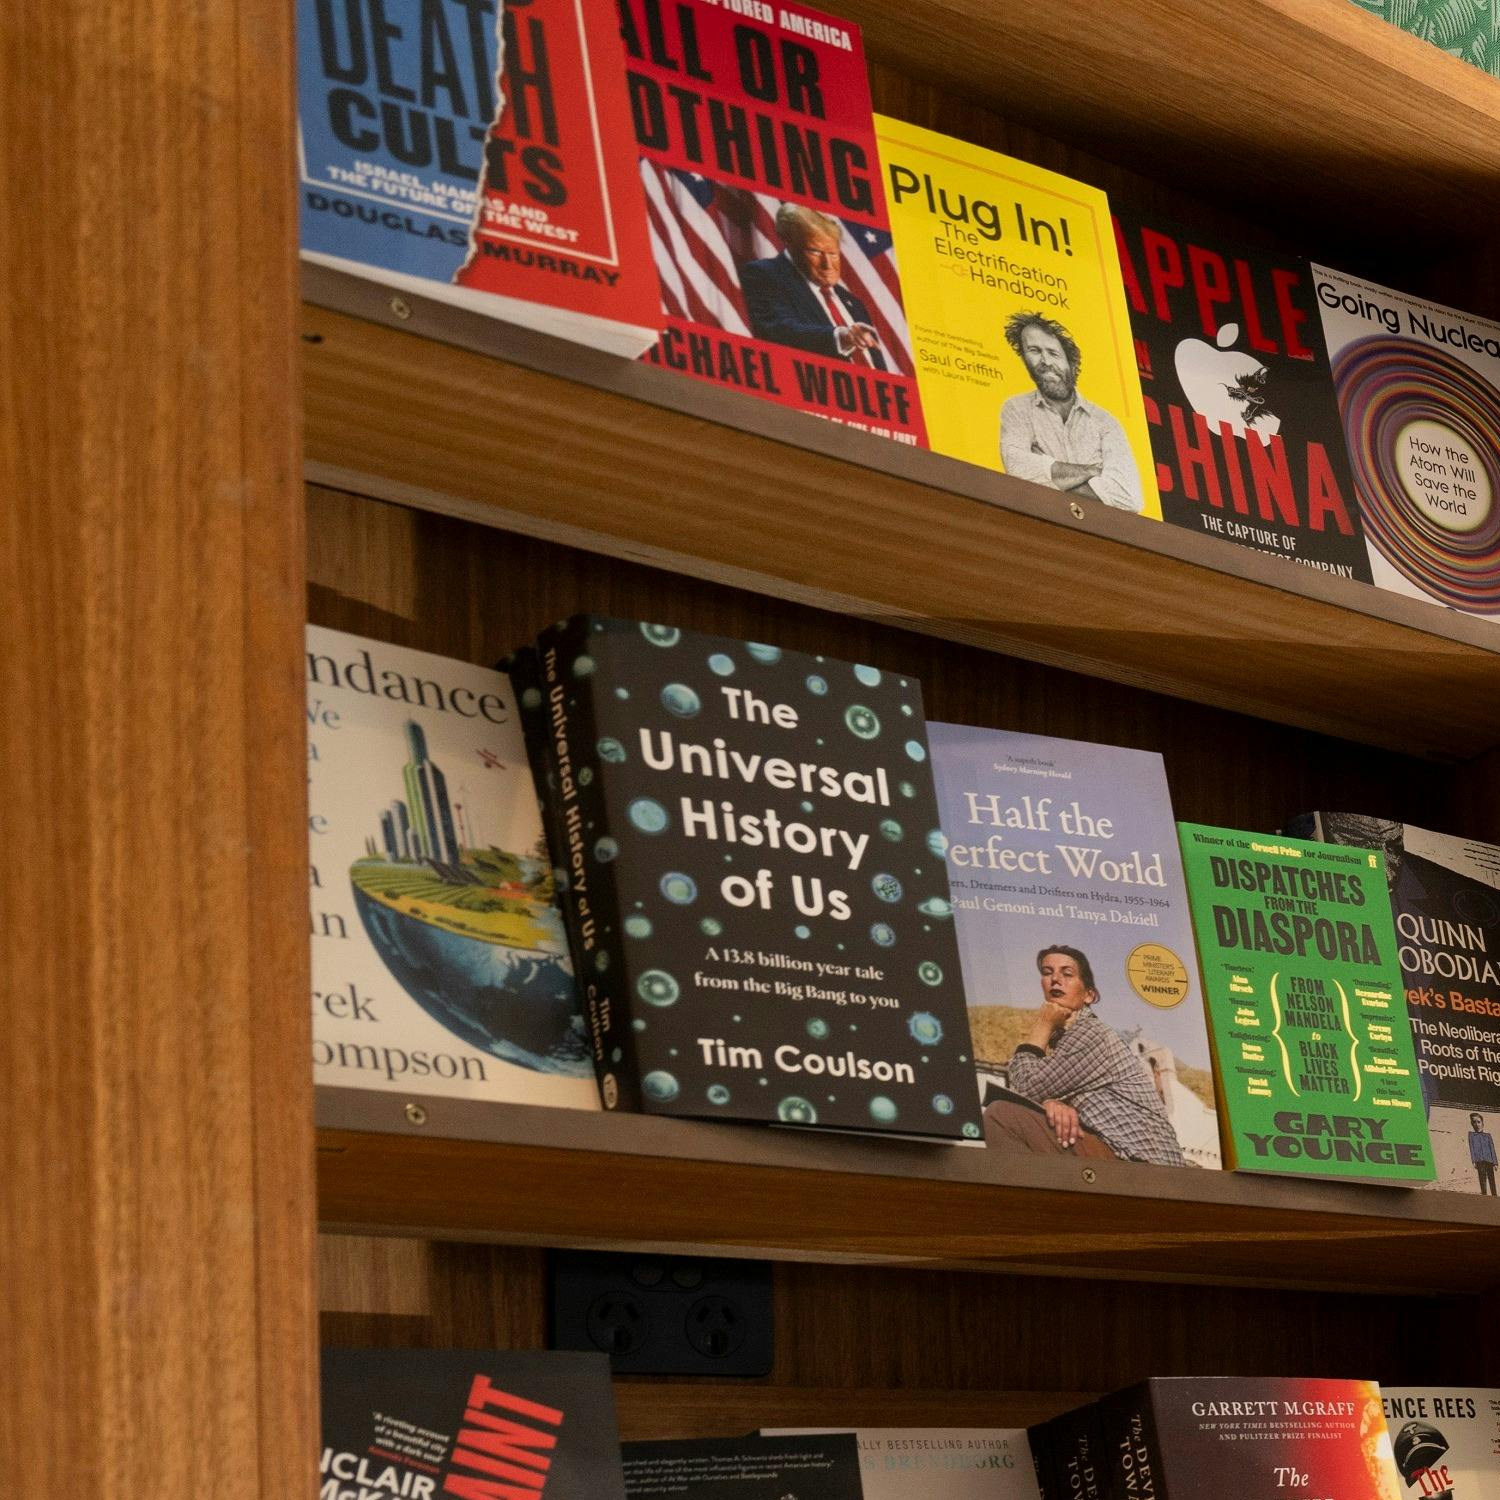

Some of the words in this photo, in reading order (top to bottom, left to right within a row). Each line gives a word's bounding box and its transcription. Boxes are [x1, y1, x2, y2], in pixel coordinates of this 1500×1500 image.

[780, 11, 853, 52] AMERICA
[733, 23, 827, 122] OR
[328, 87, 570, 208] CULTS
[888, 163, 1002, 242] Plug
[1014, 201, 1073, 257] In!
[306, 192, 470, 249] DOUGLAS
[481, 239, 621, 287] MURRAY
[940, 220, 978, 248] The
[934, 236, 1069, 291] Electrification
[969, 268, 1070, 311] Handbook
[1316, 282, 1401, 336] Going
[794, 358, 913, 427] WOLFF
[1408, 435, 1440, 460] How
[1443, 445, 1469, 464] the
[1411, 454, 1445, 476] Atom
[1449, 464, 1476, 484] Will
[1415, 472, 1447, 495] Save
[1450, 481, 1477, 501] the
[1424, 492, 1468, 516] World
[721, 685, 799, 729] The
[639, 728, 891, 806] Universal
[680, 797, 870, 870] History
[964, 791, 1051, 833] Half
[1057, 806, 1113, 839] the
[1056, 845, 1168, 889] World
[1211, 856, 1365, 906] DISPATCHES
[720, 870, 773, 910] of
[792, 875, 852, 921] Us
[1213, 905, 1382, 967] DIASPORA
[705, 948, 719, 962] A
[721, 948, 755, 964] 13.8
[758, 952, 813, 973] billion
[816, 959, 850, 979] year
[854, 961, 884, 980] tale
[1287, 992, 1334, 1013] NELSON
[1290, 975, 1325, 996] FROM
[1285, 1010, 1342, 1032] MANDELA
[1413, 1019, 1436, 1036] The
[697, 1038, 762, 1069] Tim
[774, 1044, 915, 1084] Coulson
[1299, 1040, 1339, 1060] BLACK
[1304, 1057, 1340, 1076] LIVES
[1299, 1075, 1349, 1095] MATTER
[1273, 1112, 1390, 1140] GARY
[1244, 1132, 1426, 1168] YOUNGE
[1191, 1402, 1274, 1417] GARRETT
[1274, 1468, 1309, 1488] The
